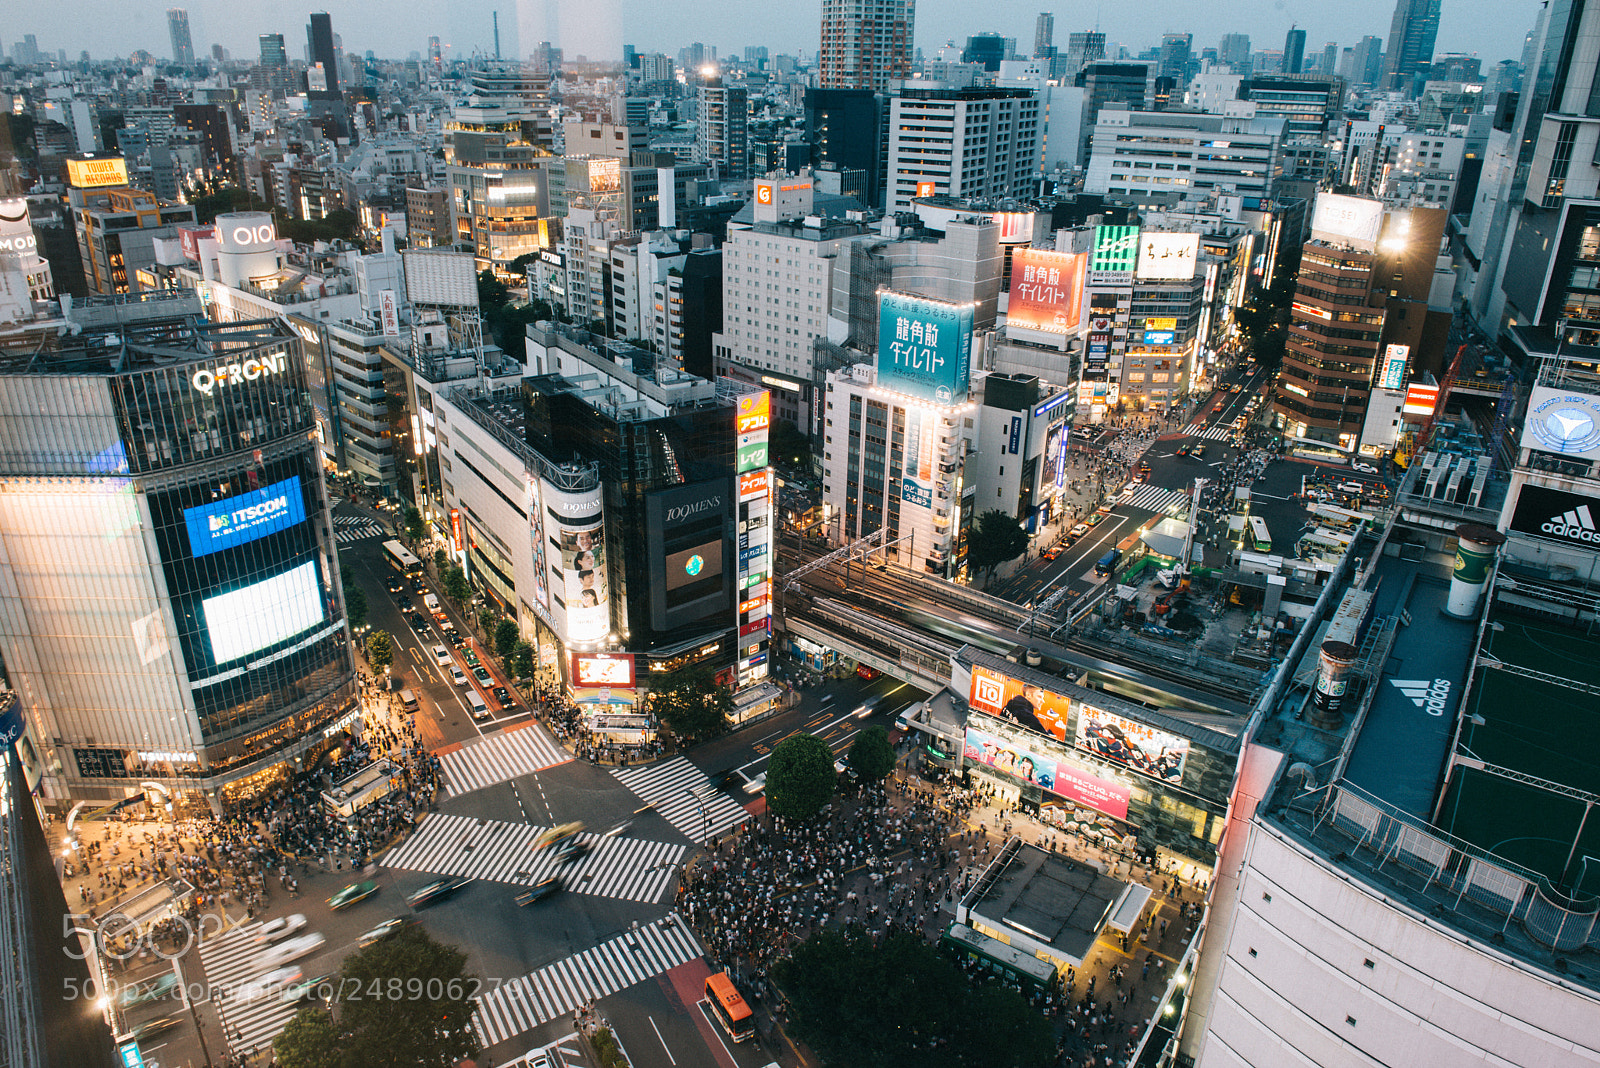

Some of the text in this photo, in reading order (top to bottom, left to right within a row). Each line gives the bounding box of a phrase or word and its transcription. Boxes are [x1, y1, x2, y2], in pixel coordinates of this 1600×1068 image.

[86, 162, 114, 173] TOWER
[85, 172, 122, 185] RECORDS
[1325, 207, 1357, 220] TOSEI
[1147, 242, 1191, 260] ちふれ
[896, 316, 939, 348] 龍角散
[192, 351, 286, 397] QFRONT
[1534, 396, 1561, 414] TOKYU
[740, 416, 769, 431] アコム
[741, 448, 766, 465] レイク
[741, 476, 767, 491] アイフル
[231, 495, 289, 524] ITSCOM
[1541, 521, 1600, 543] adidas
[981, 685, 999, 702] 10
[1425, 678, 1451, 717] adidas
[323, 709, 361, 738] TSUTAYA
[138, 752, 198, 762] TSUTAYA
